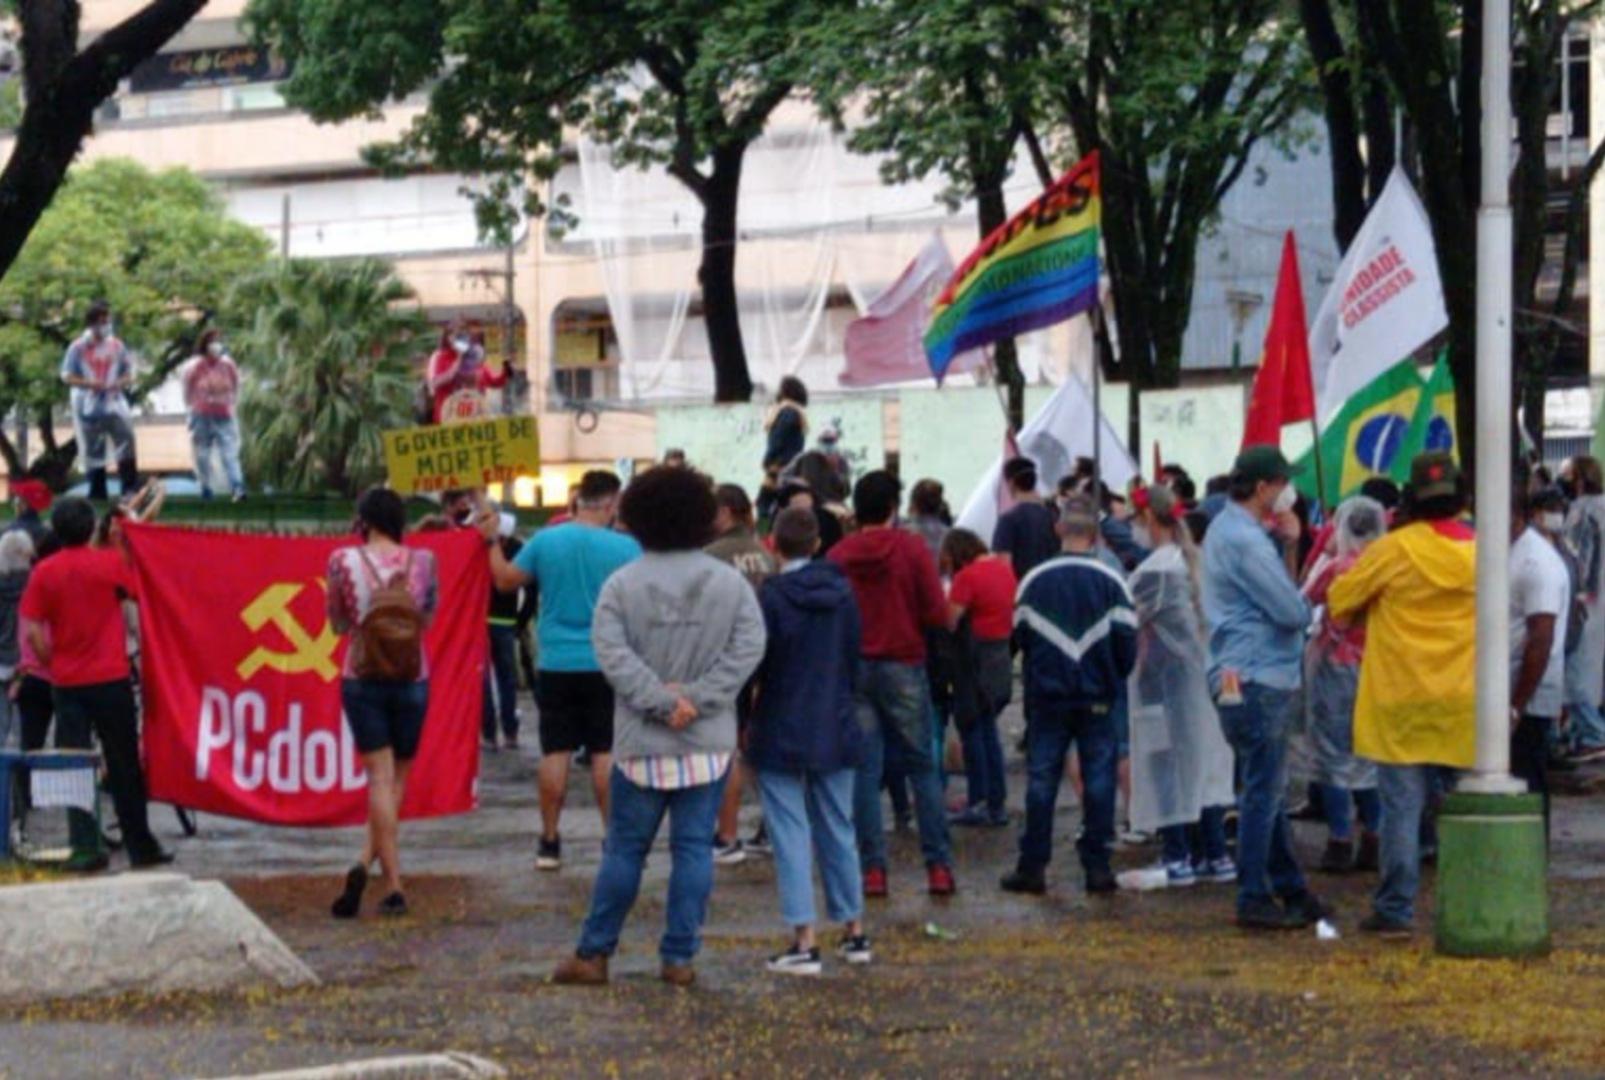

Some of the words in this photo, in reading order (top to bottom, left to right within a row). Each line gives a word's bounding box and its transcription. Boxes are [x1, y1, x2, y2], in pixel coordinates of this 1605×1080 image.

[1337, 246, 1404, 314] NIDADE
[1344, 268, 1416, 328] CLASSISTA
[395, 421, 496, 456] GOVERNO
[508, 417, 531, 438] DE
[417, 443, 504, 475] MORTE
